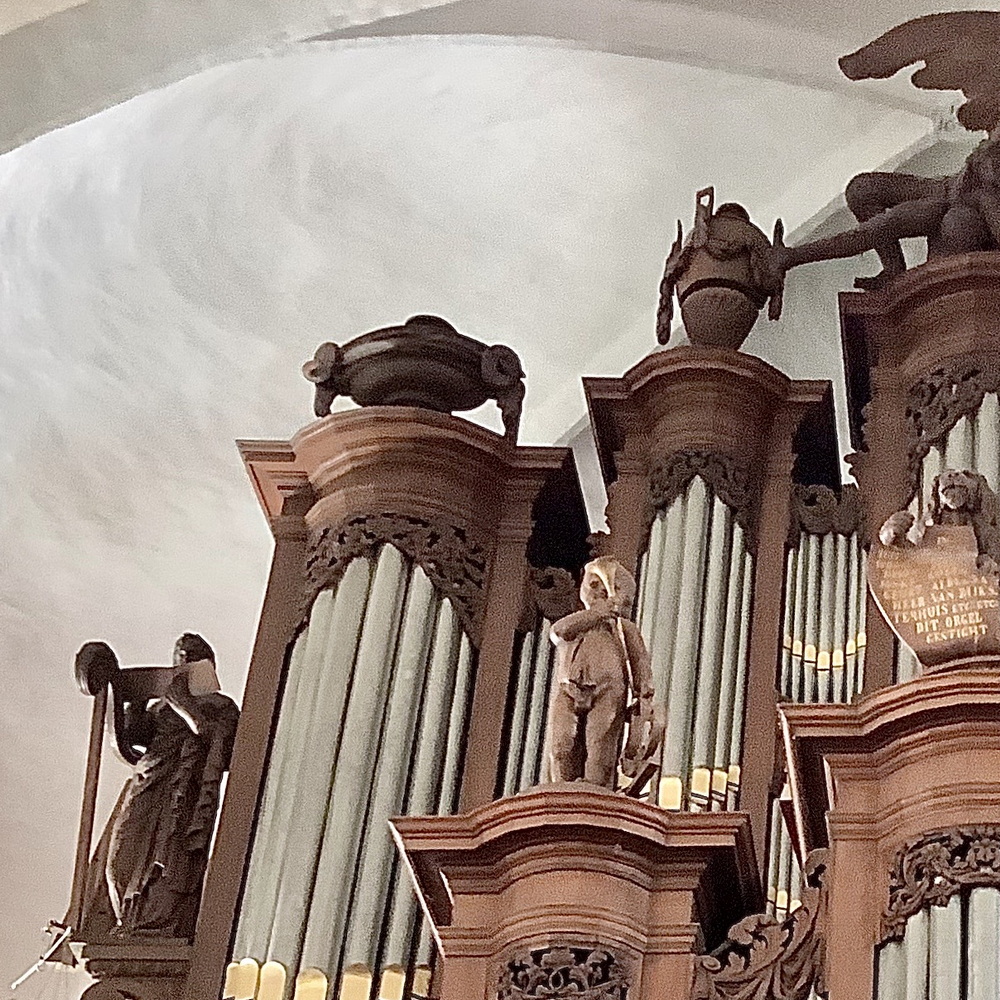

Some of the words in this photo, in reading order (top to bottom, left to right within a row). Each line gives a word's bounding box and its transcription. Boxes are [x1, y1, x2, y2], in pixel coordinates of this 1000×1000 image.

[931, 591, 954, 602] VAN
[916, 619, 939, 634] DIT
[945, 611, 983, 628] ORGEL
[926, 624, 988, 644] GESTICHT
